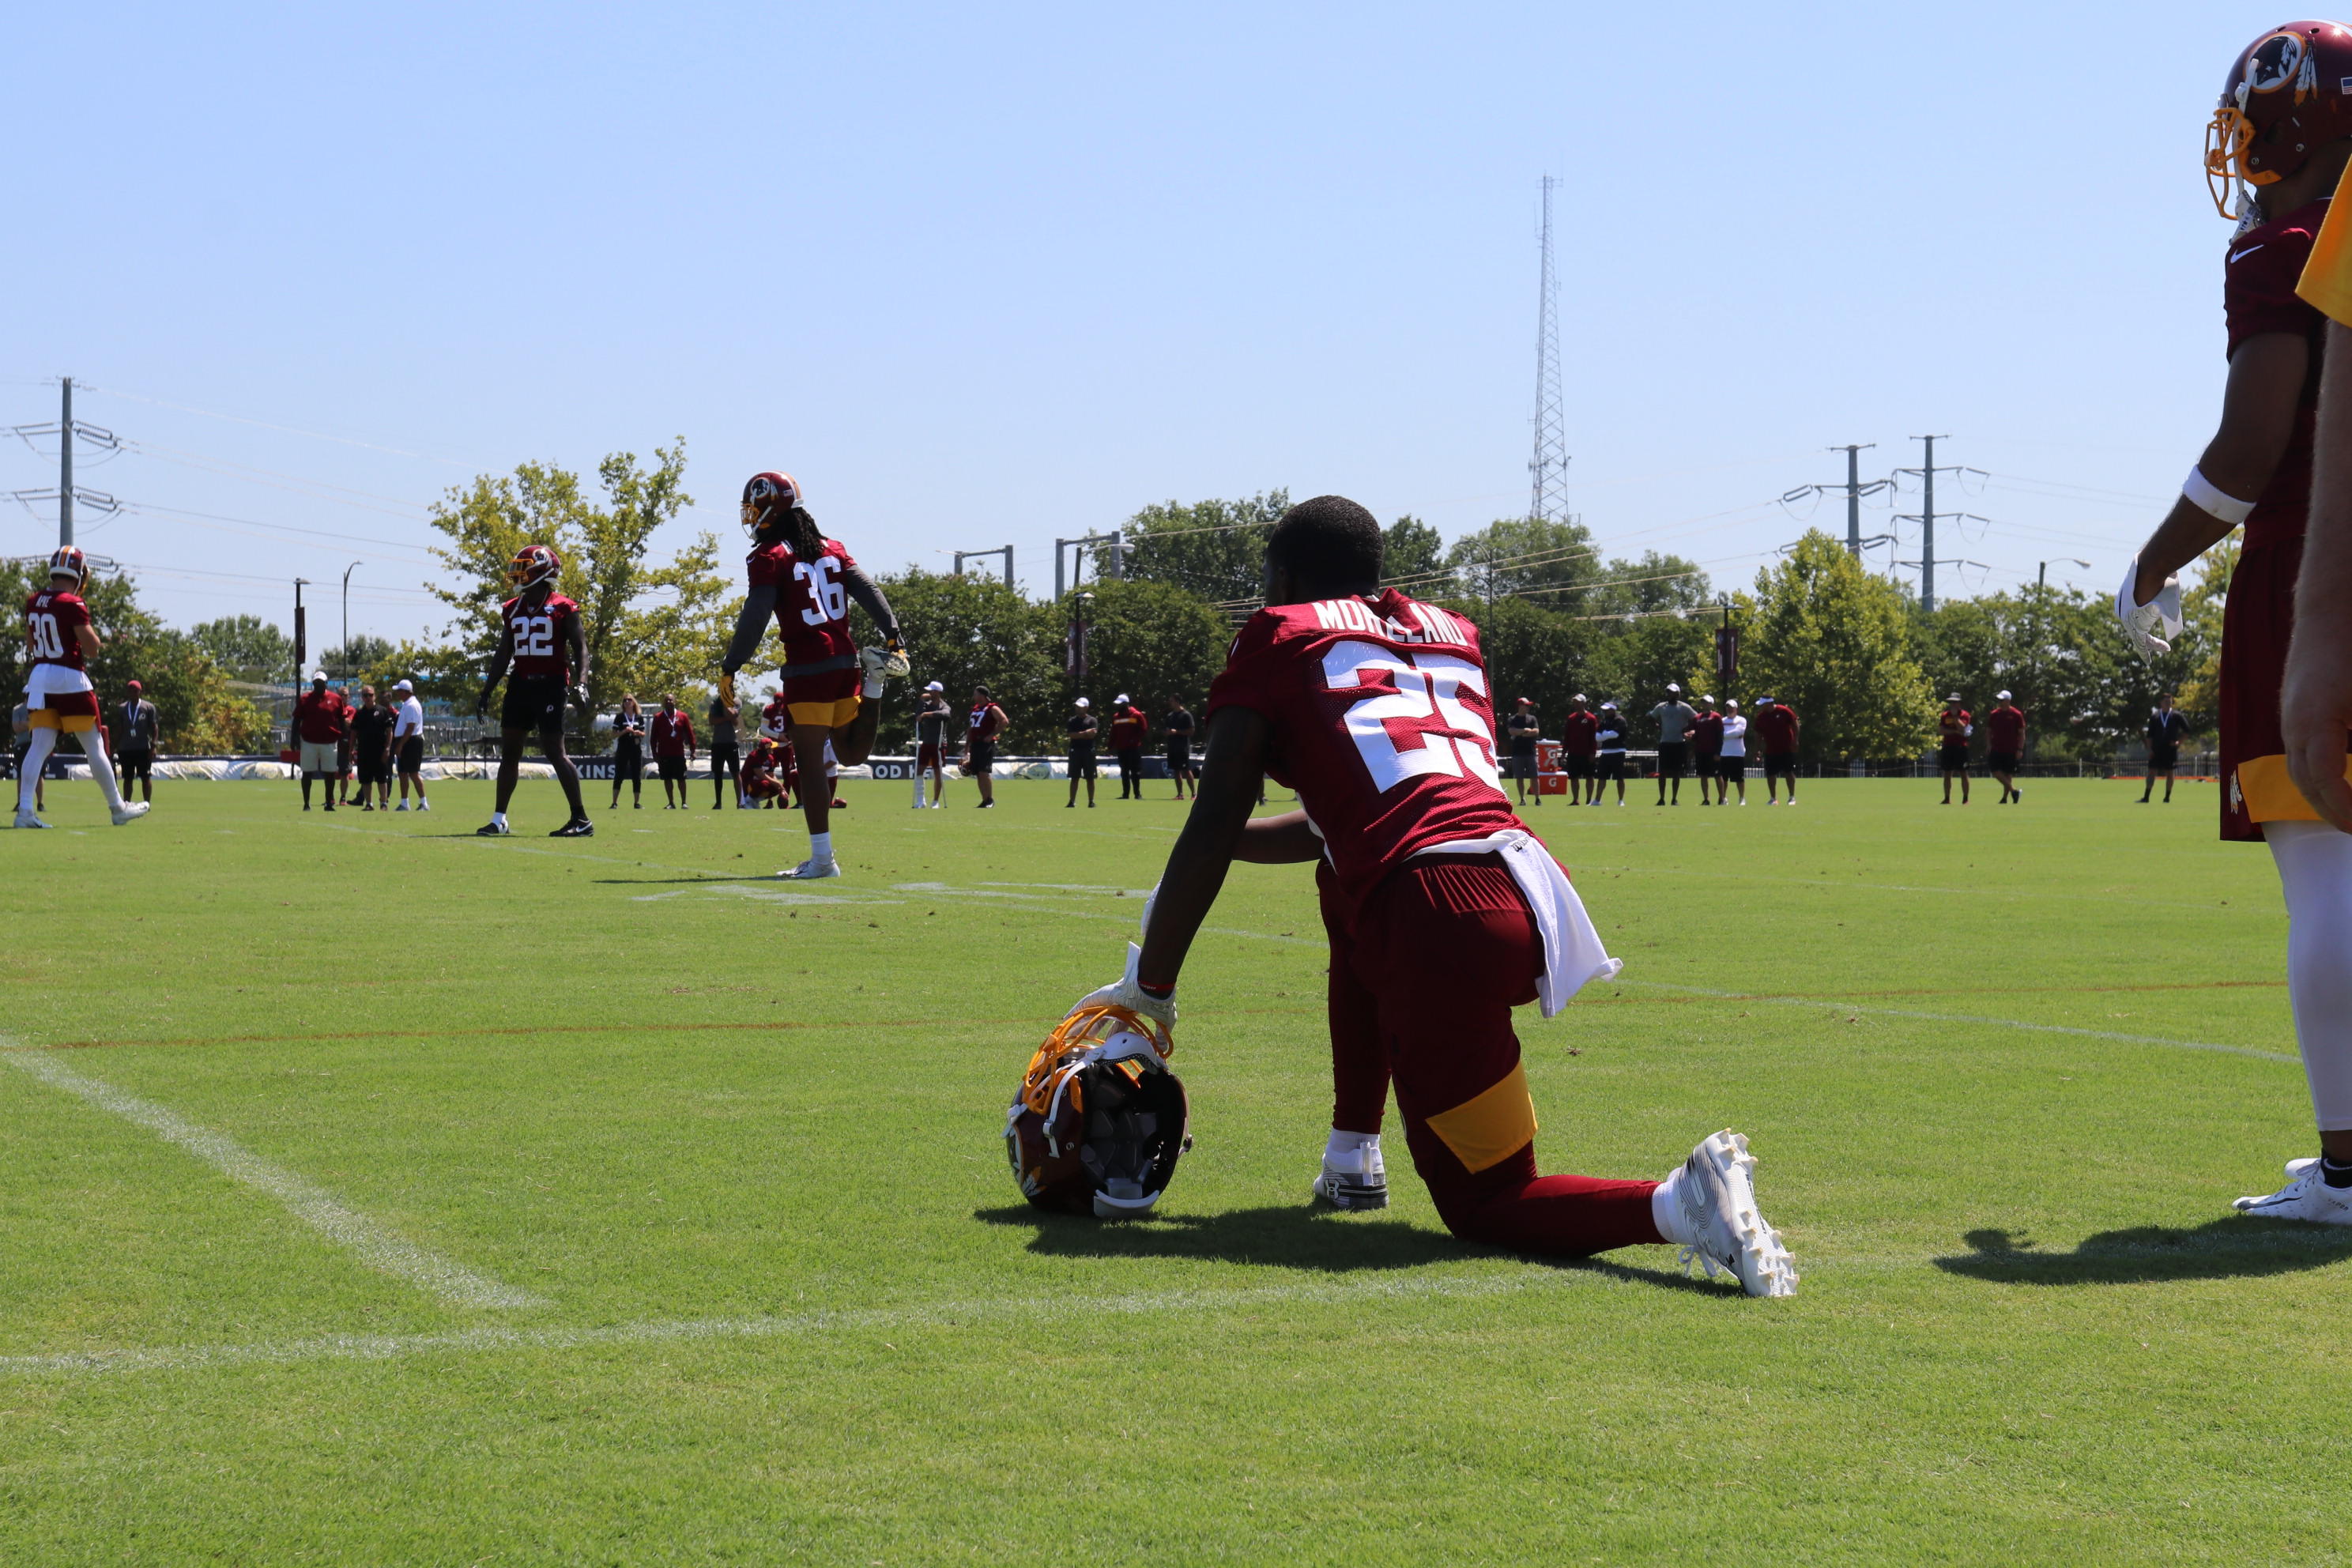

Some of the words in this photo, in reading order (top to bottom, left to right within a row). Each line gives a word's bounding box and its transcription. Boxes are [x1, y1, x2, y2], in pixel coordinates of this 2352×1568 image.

[793, 555, 846, 626] 36
[28, 612, 64, 659] 30
[511, 616, 553, 656] 22
[1321, 640, 1504, 794] 25
[1547, 749, 1556, 759] G
[1548, 778, 1557, 788] G
